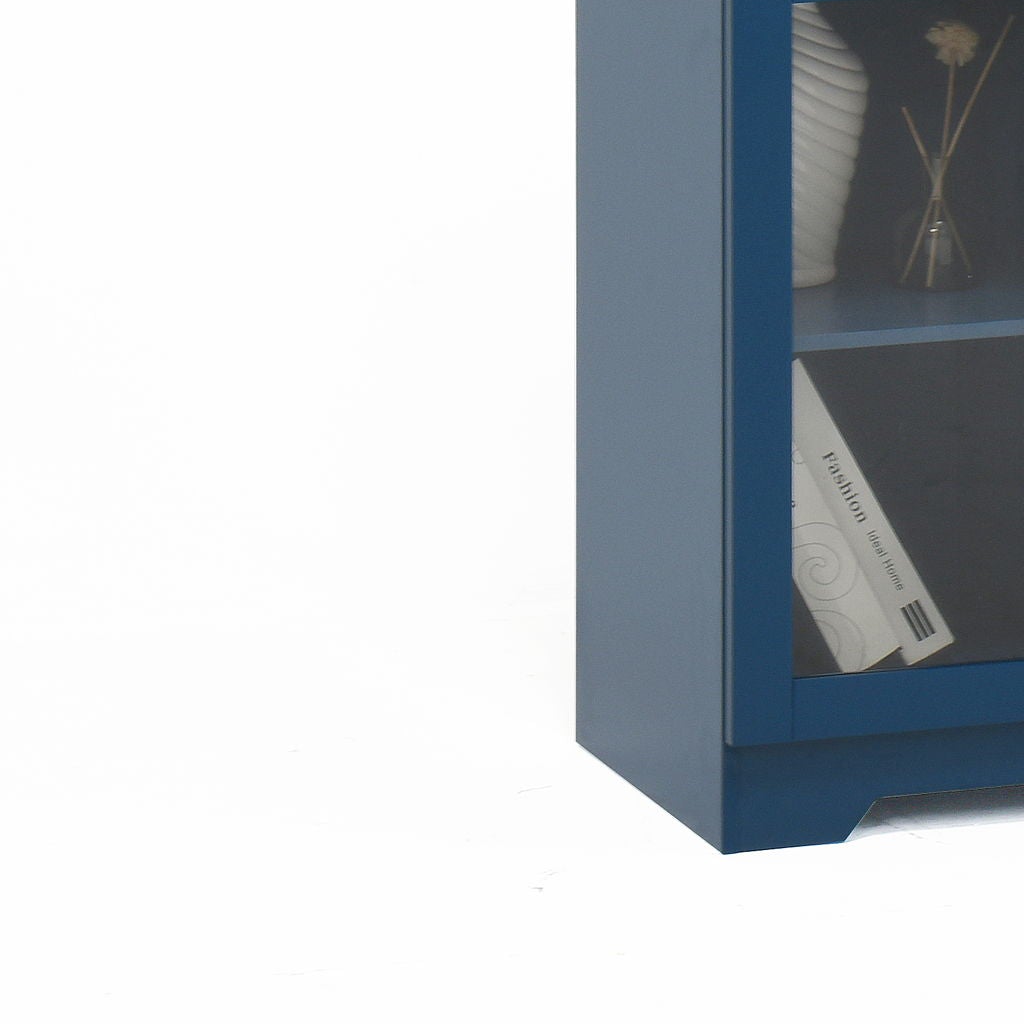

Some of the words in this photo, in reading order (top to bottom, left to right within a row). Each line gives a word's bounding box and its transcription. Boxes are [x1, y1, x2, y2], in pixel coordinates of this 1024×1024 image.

[822, 451, 867, 523] Fashion
[867, 529, 888, 558] Ideal
[882, 557, 904, 592] Home
